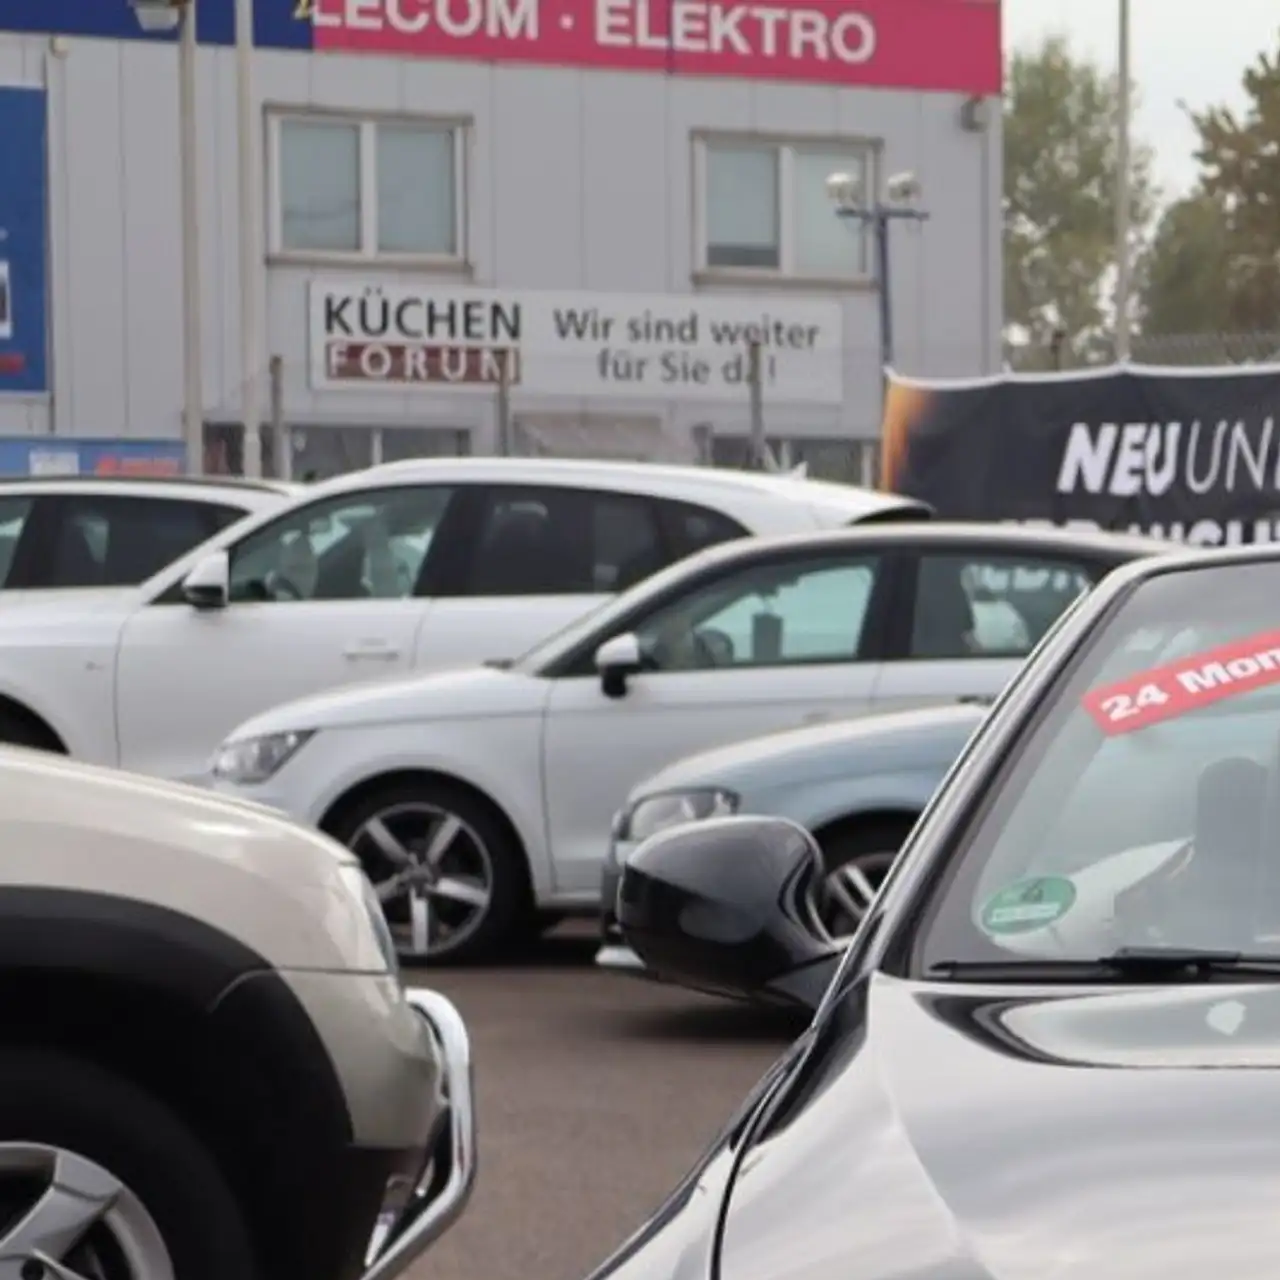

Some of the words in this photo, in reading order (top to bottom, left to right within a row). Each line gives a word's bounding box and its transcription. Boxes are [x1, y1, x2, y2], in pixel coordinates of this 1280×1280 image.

[595, 0, 876, 63] ELEKTRO
[324, 285, 521, 340] KÜCHEN
[553, 307, 614, 340] Wir
[627, 308, 698, 345] sind
[709, 312, 820, 349] weiter
[597, 348, 647, 383] für
[660, 350, 711, 385] Sie
[720, 352, 776, 388] d!
[1056, 422, 1180, 495] NEU
[1101, 684, 1170, 722] 24
